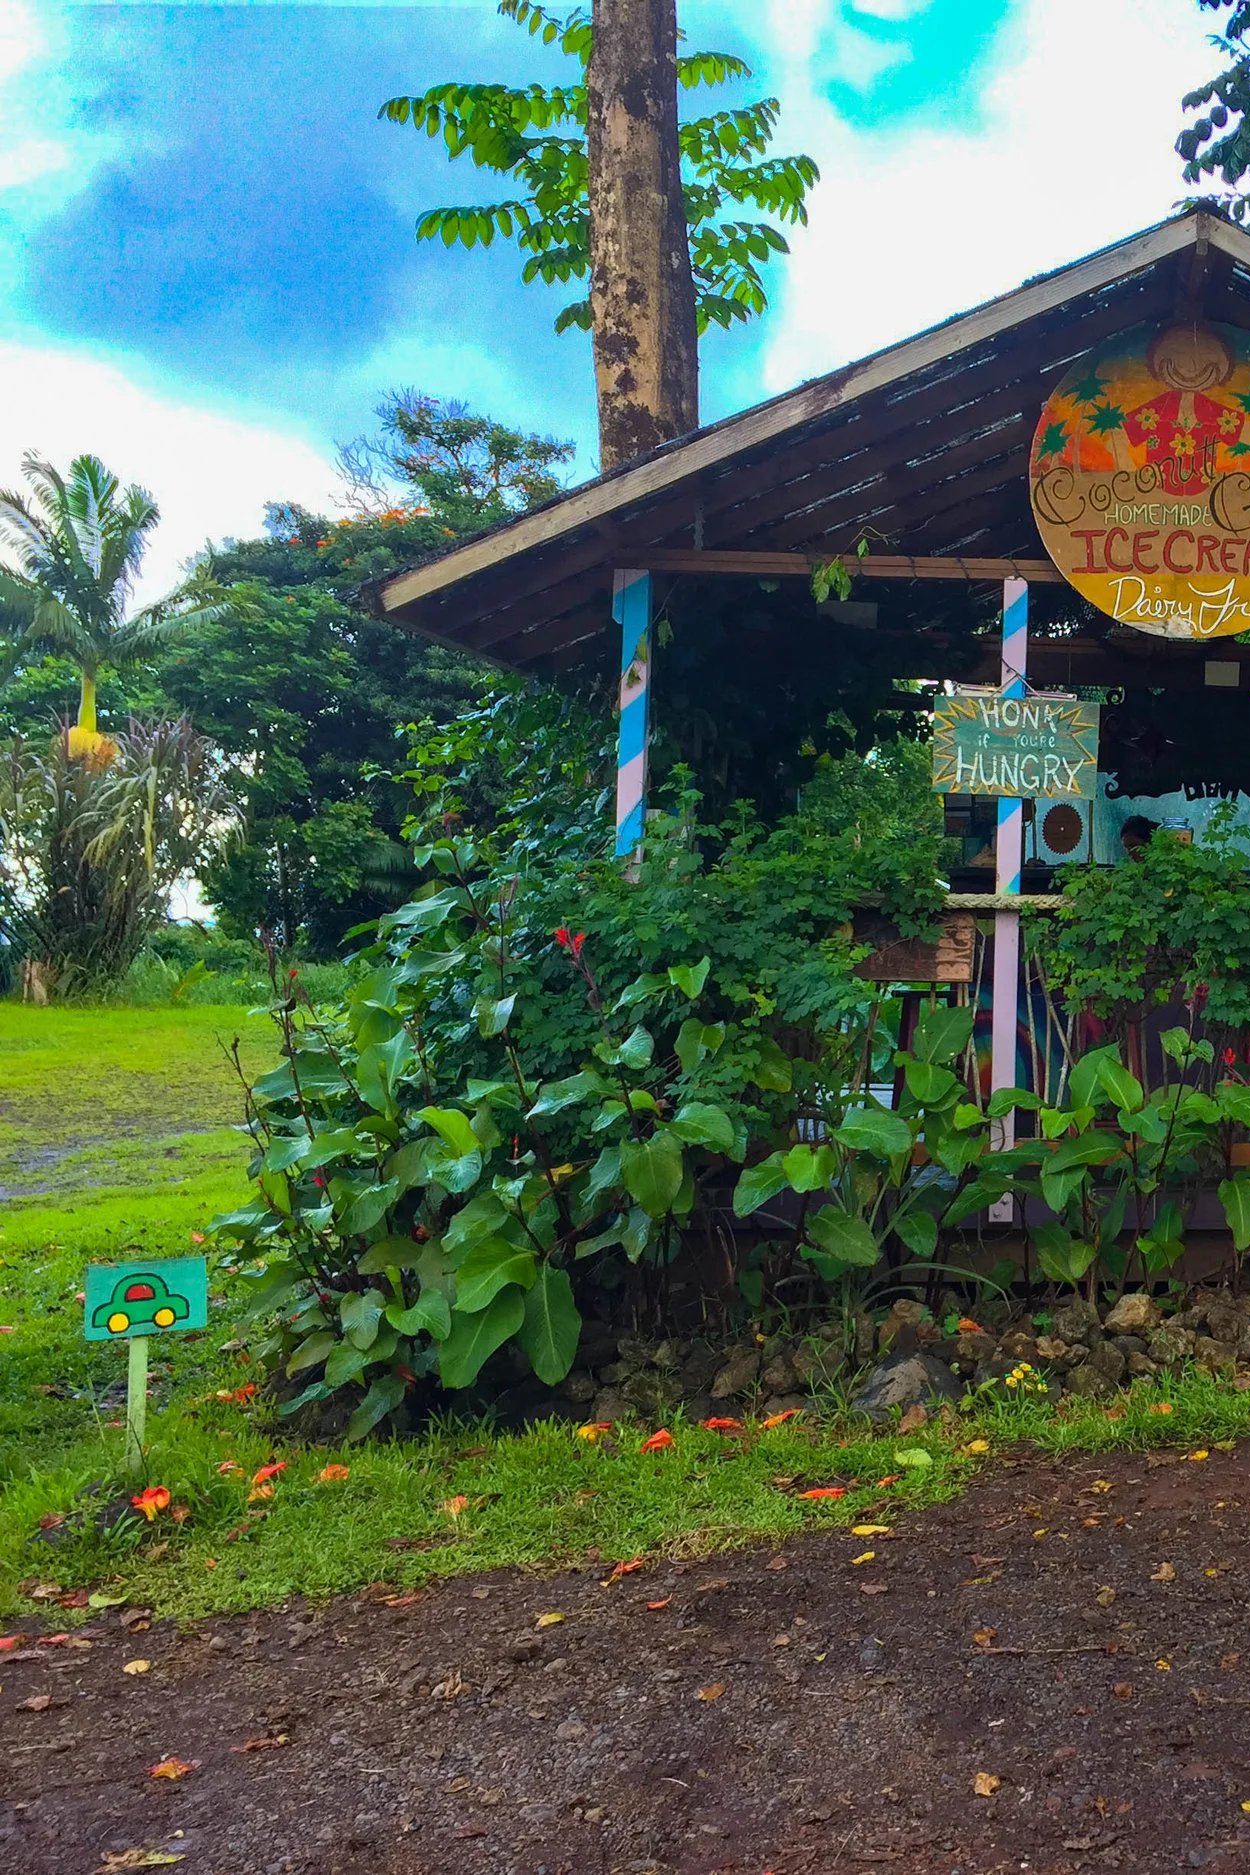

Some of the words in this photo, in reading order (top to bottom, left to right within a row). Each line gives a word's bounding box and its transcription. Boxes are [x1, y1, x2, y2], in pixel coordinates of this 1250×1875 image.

[1070, 530, 1160, 575] ICE
[1108, 576, 1197, 630] Dairy
[979, 698, 1064, 733] HONK
[955, 746, 1085, 792] HUNGRY
